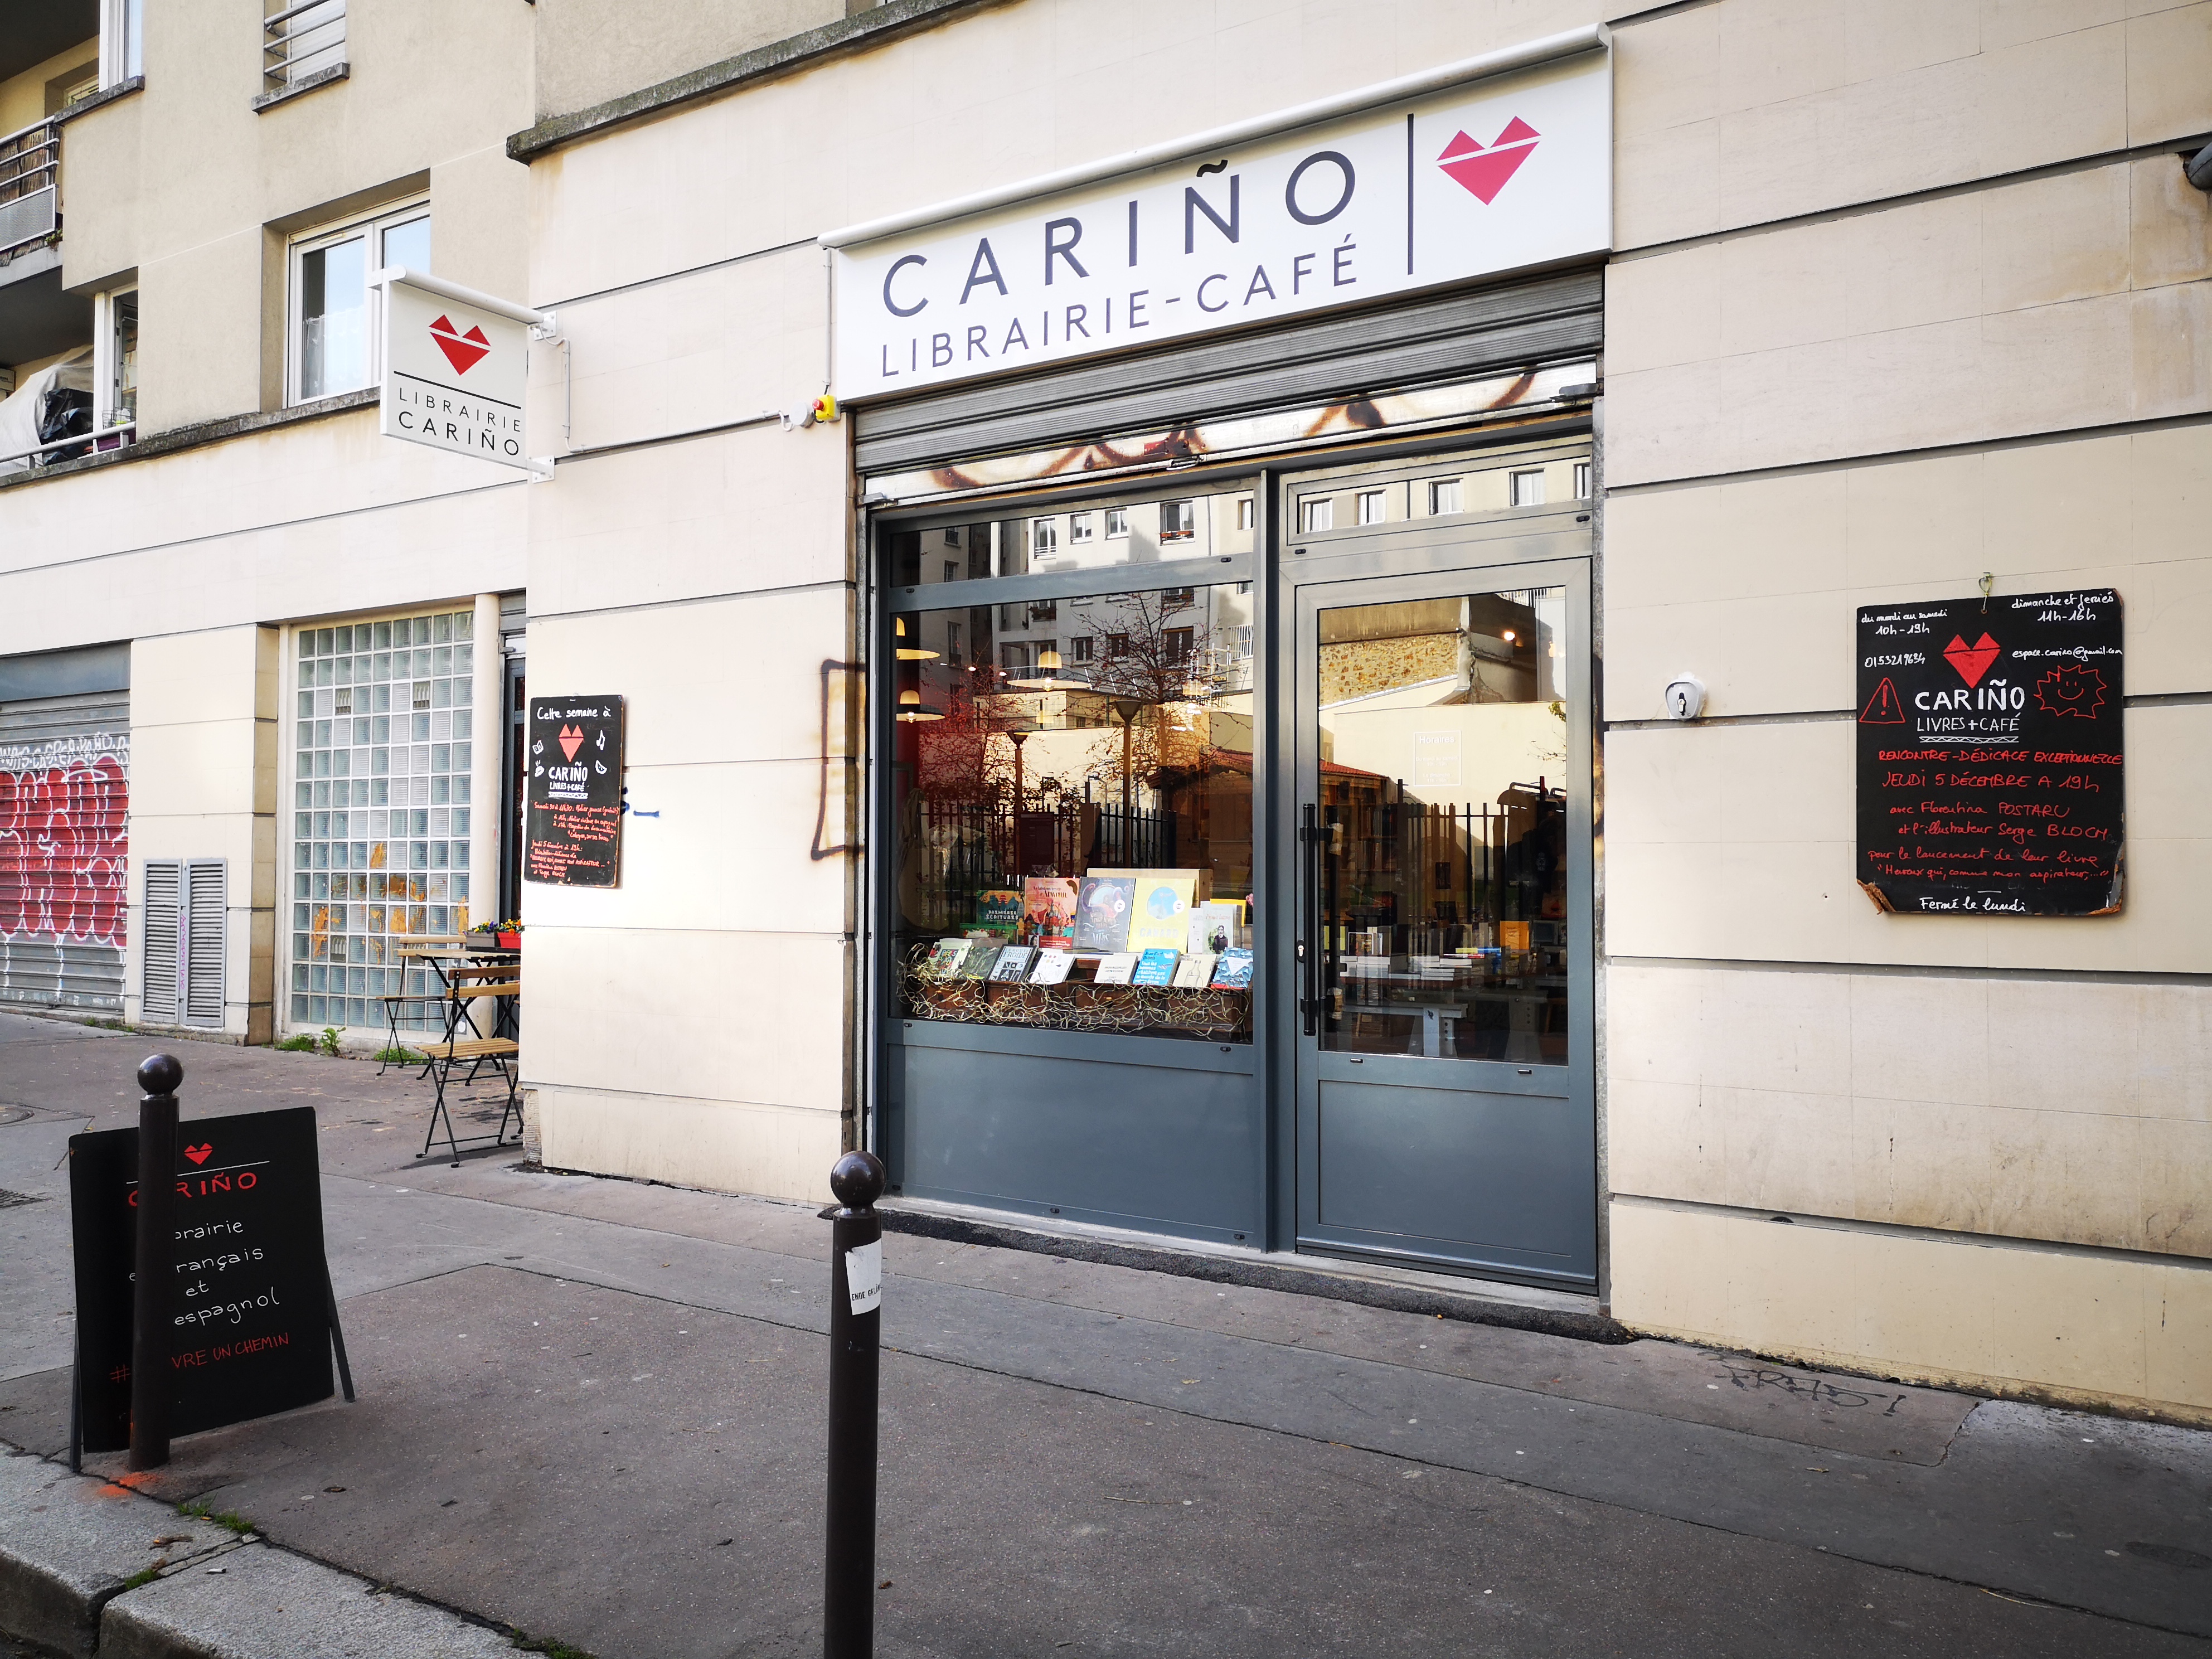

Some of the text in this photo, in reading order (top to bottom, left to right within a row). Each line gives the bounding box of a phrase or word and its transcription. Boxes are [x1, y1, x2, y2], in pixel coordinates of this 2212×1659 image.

[882, 150, 1356, 319] CARIÑO
[882, 233, 1357, 379] LIBRAIRIE-CAFÉ
[399, 387, 521, 433] LIBRAIRIE
[399, 410, 519, 456] CARIÑO
[2011, 595, 2062, 609] dimanche
[2064, 593, 2074, 605] et
[1861, 614, 1874, 623] du
[1876, 612, 1901, 622] mardi
[1919, 609, 1947, 619] samedi
[1915, 679, 2026, 711] CARIÑO
[537, 705, 612, 720] Cette semaine à
[1419, 735, 1456, 744] Horaires
[2034, 750, 2123, 764] EXCEPTIONNELLE
[549, 761, 588, 782] CARIÑO
[1936, 773, 1946, 786] 5
[1950, 771, 2031, 788] DÉCEMBRE
[2038, 775, 2053, 788] A
[1921, 801, 1988, 814] Florentina
[1898, 824, 1910, 835] et
[1998, 822, 2036, 845] Serge
[2047, 823, 2109, 841] BLOCH
[1867, 846, 2099, 868] pour le lancement de leur livre
[1919, 896, 2026, 912] Fermé le lundi
[1139, 928, 1180, 939] CANARD
[128, 1172, 257, 1207] CRIÑO
[174, 1220, 244, 1240] rairie
[176, 1248, 263, 1272] rançais
[185, 1279, 210, 1297] et
[851, 1291, 865, 1301] ENDE
[174, 1285, 281, 1326] espagnol
[213, 1344, 231, 1361] UN
[235, 1332, 289, 1355] CHEMIN
